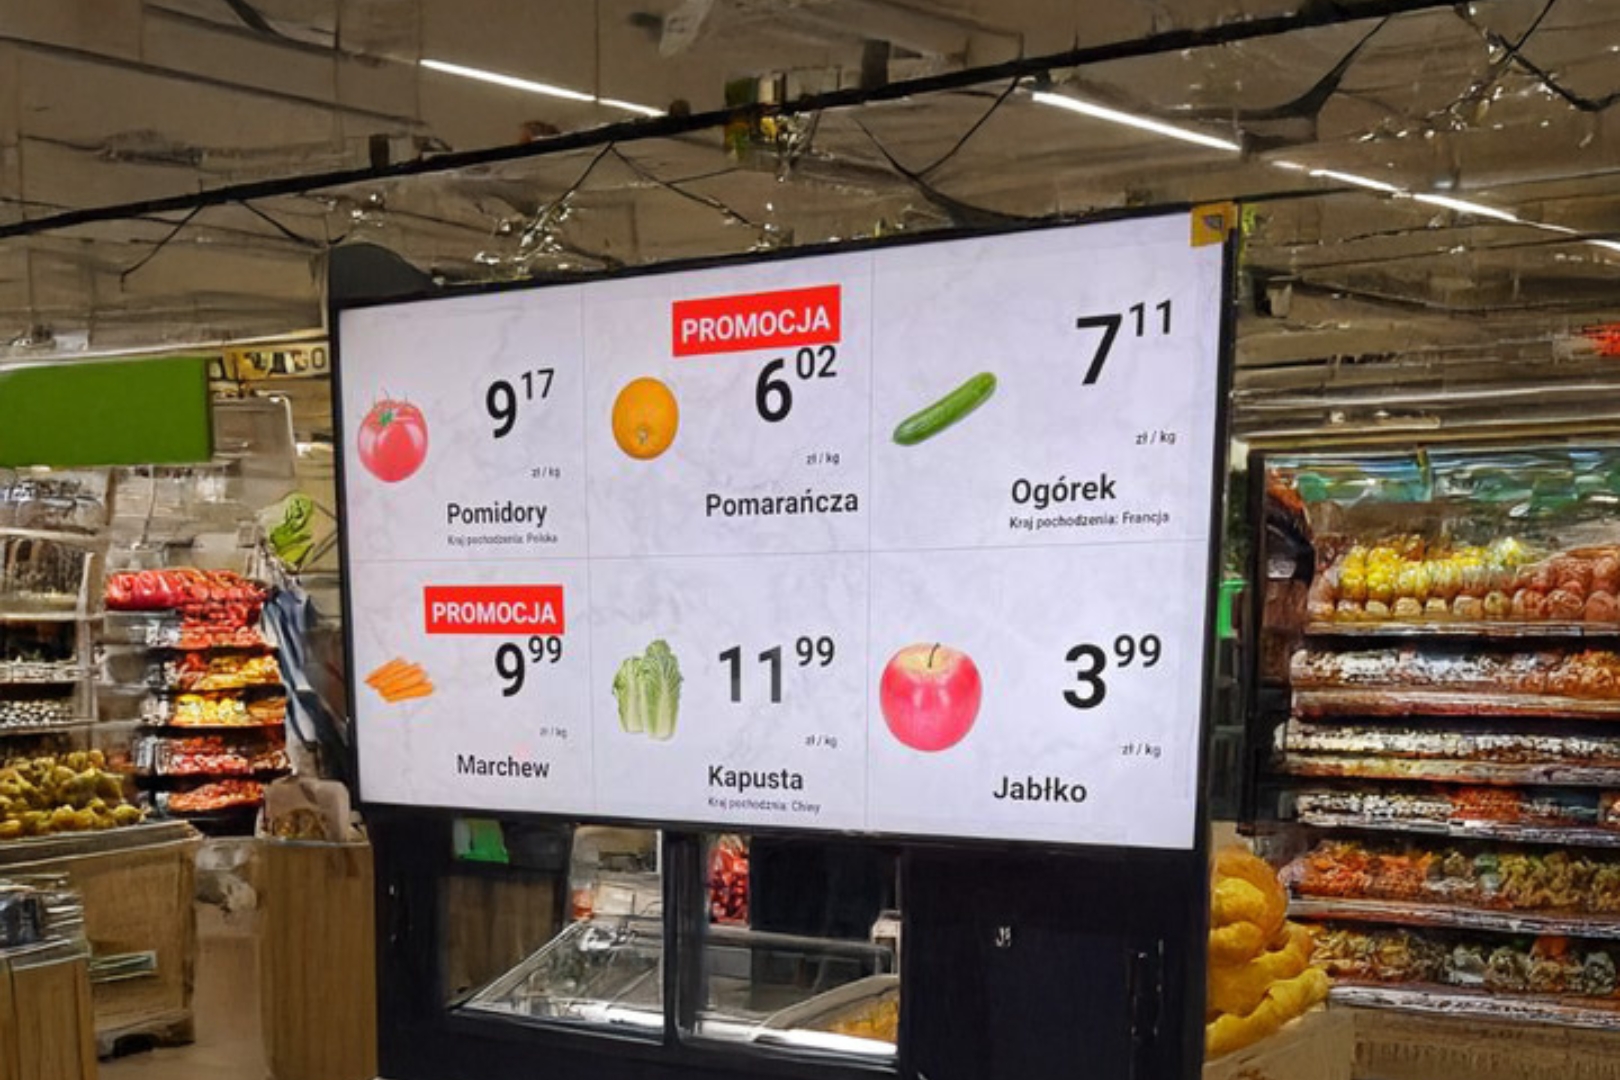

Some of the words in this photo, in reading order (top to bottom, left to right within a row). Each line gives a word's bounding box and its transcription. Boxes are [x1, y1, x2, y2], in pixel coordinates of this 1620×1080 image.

[681, 305, 831, 343] PROMOCJA
[1076, 313, 1123, 386] 7
[1129, 299, 1172, 337] 11
[755, 358, 794, 423] 6
[796, 345, 838, 380] 02
[485, 380, 518, 439] 9
[521, 367, 555, 400] 17
[1134, 430, 1148, 445] zł
[1160, 430, 1176, 446] kg
[706, 488, 859, 517] Pomarańcza
[1011, 472, 1116, 510] Ogórek
[447, 500, 547, 528] Pomidory
[1009, 516, 1033, 530] Kraj
[1036, 513, 1119, 530] pochodzenia:
[1122, 510, 1170, 526] Francja
[447, 534, 464, 546] Kraj
[526, 531, 558, 544] Polska
[431, 600, 557, 625] PROMOCJA
[494, 642, 526, 697] 9
[530, 635, 562, 664] 99
[718, 645, 783, 704] 11
[796, 636, 835, 667] 99
[1063, 643, 1107, 710] 3
[1113, 634, 1162, 668] 99
[1144, 743, 1161, 758] kg
[457, 754, 550, 779] Marchew
[708, 765, 803, 794] Kapusta
[708, 796, 727, 809] Kraj
[993, 776, 1087, 803] Jabłko
